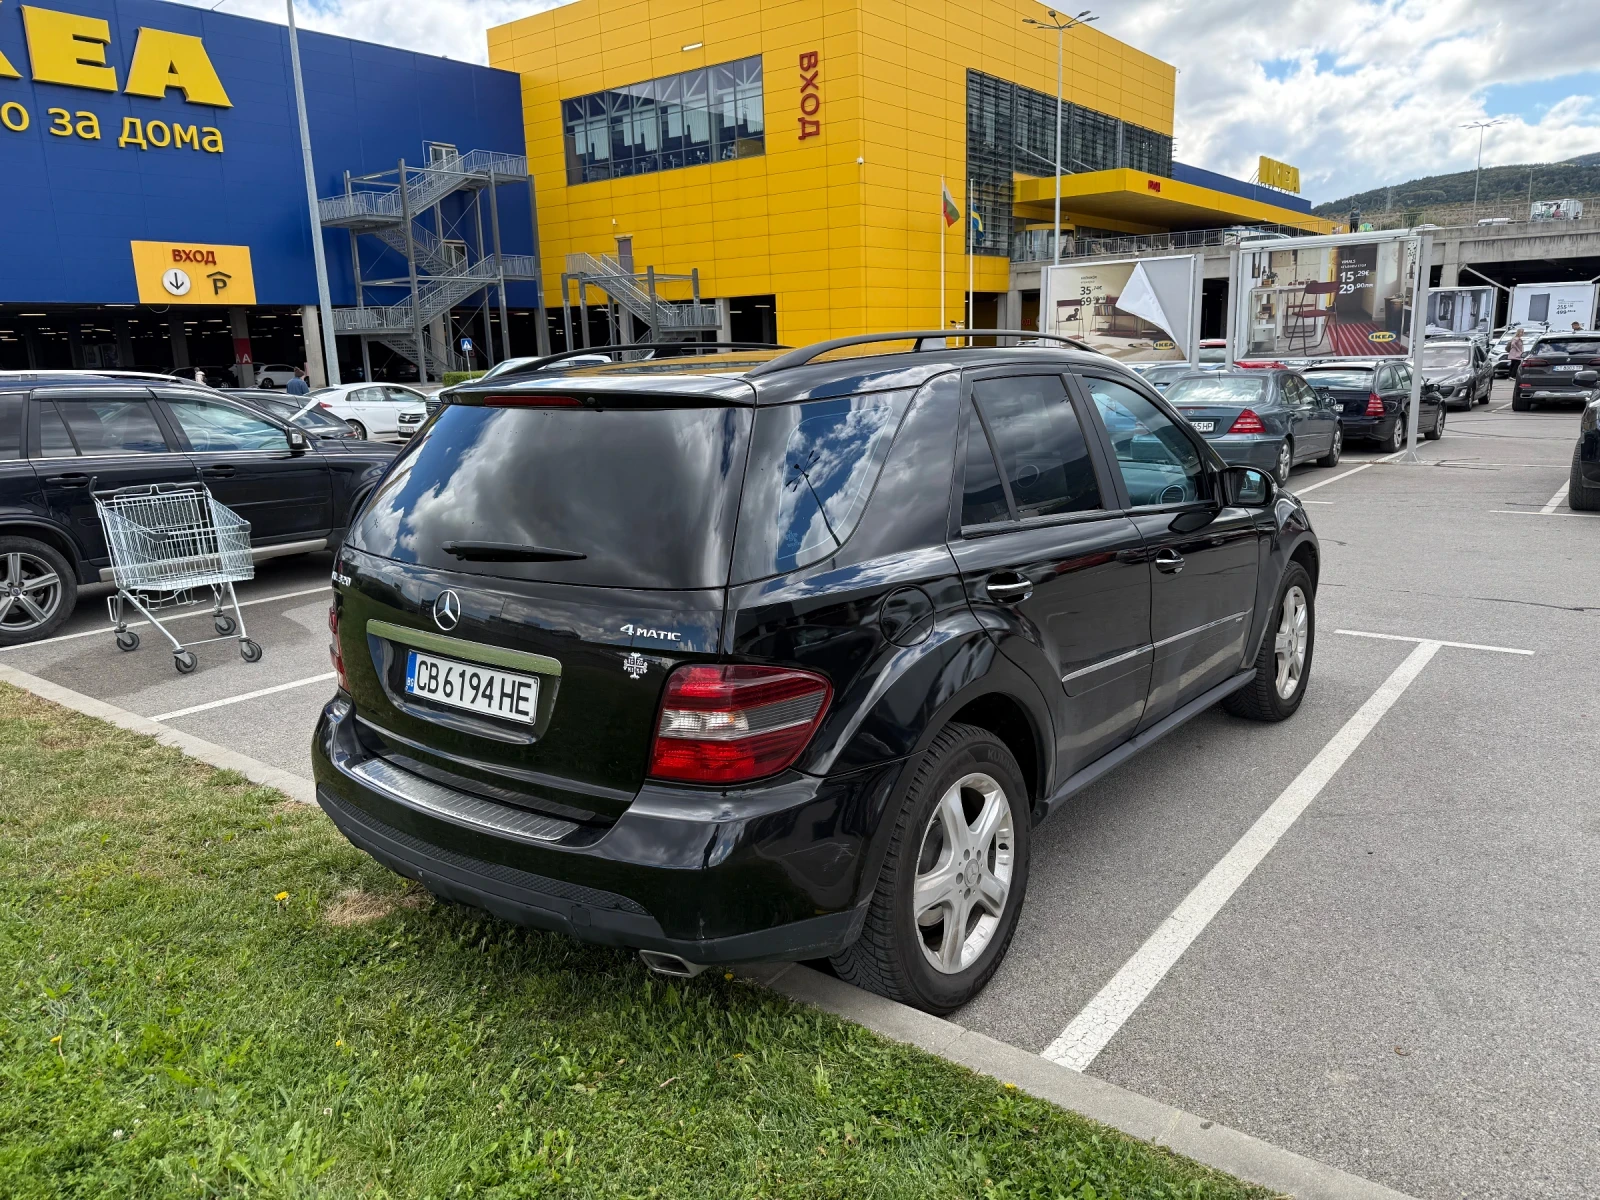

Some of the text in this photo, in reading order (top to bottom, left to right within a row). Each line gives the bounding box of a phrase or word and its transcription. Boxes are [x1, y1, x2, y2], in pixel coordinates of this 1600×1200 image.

[0, 5, 234, 108] EA
[798, 50, 820, 140] ВХОД
[48, 108, 101, 140] за
[118, 117, 224, 153] дома
[172, 249, 217, 266] ВХОД
[242, 353, 252, 364] A
